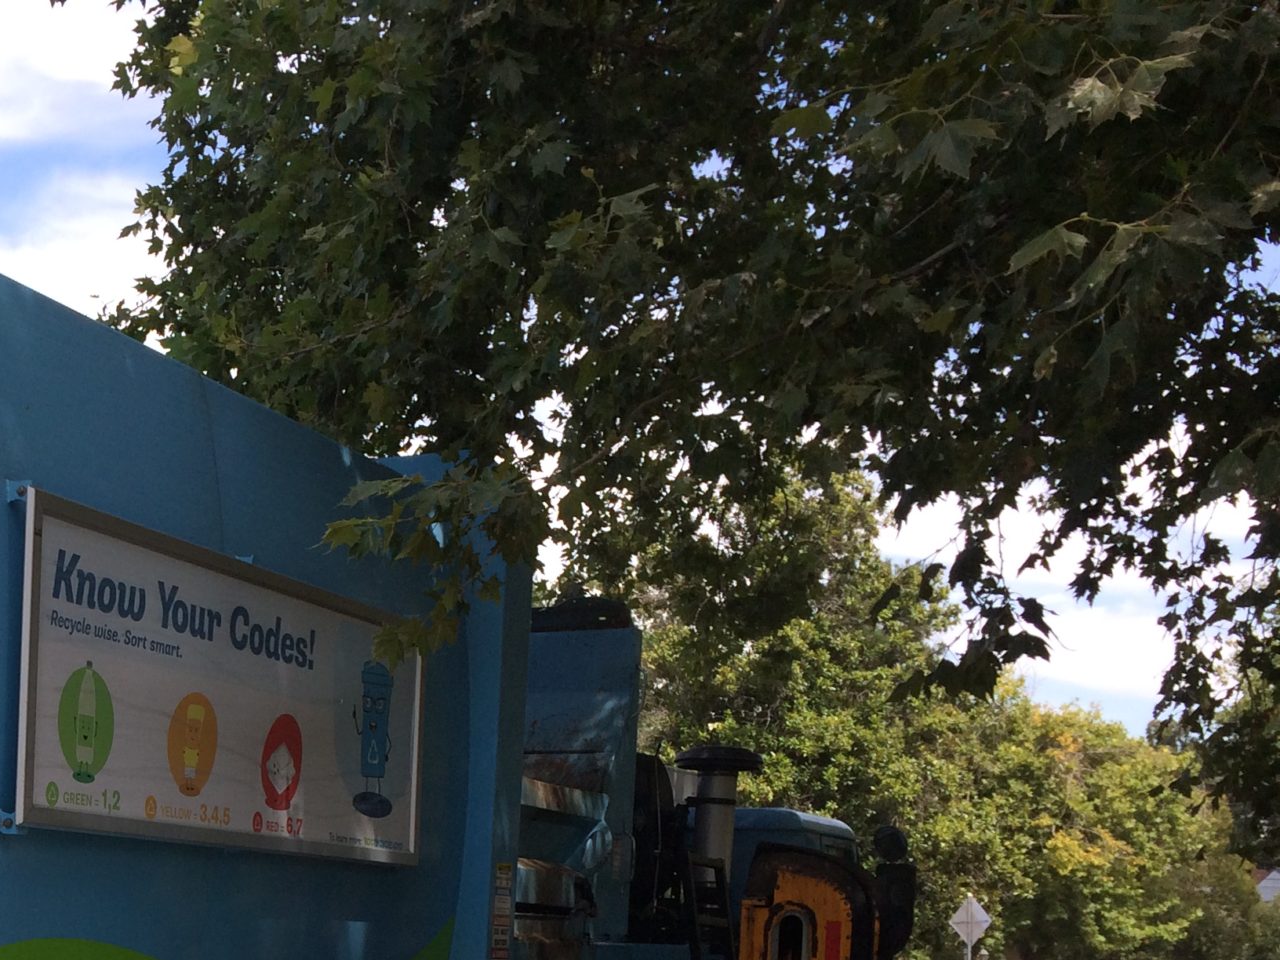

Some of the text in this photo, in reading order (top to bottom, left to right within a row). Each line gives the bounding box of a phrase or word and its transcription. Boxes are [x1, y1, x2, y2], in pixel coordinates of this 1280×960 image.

[52, 549, 316, 670] Know Your Codes!
[50, 609, 183, 659] Recycle wise. Sort smart.
[63, 791, 92, 807] GREEN
[102, 788, 120, 815] 1,2
[266, 820, 280, 832] RED
[286, 816, 304, 836] 6,7
